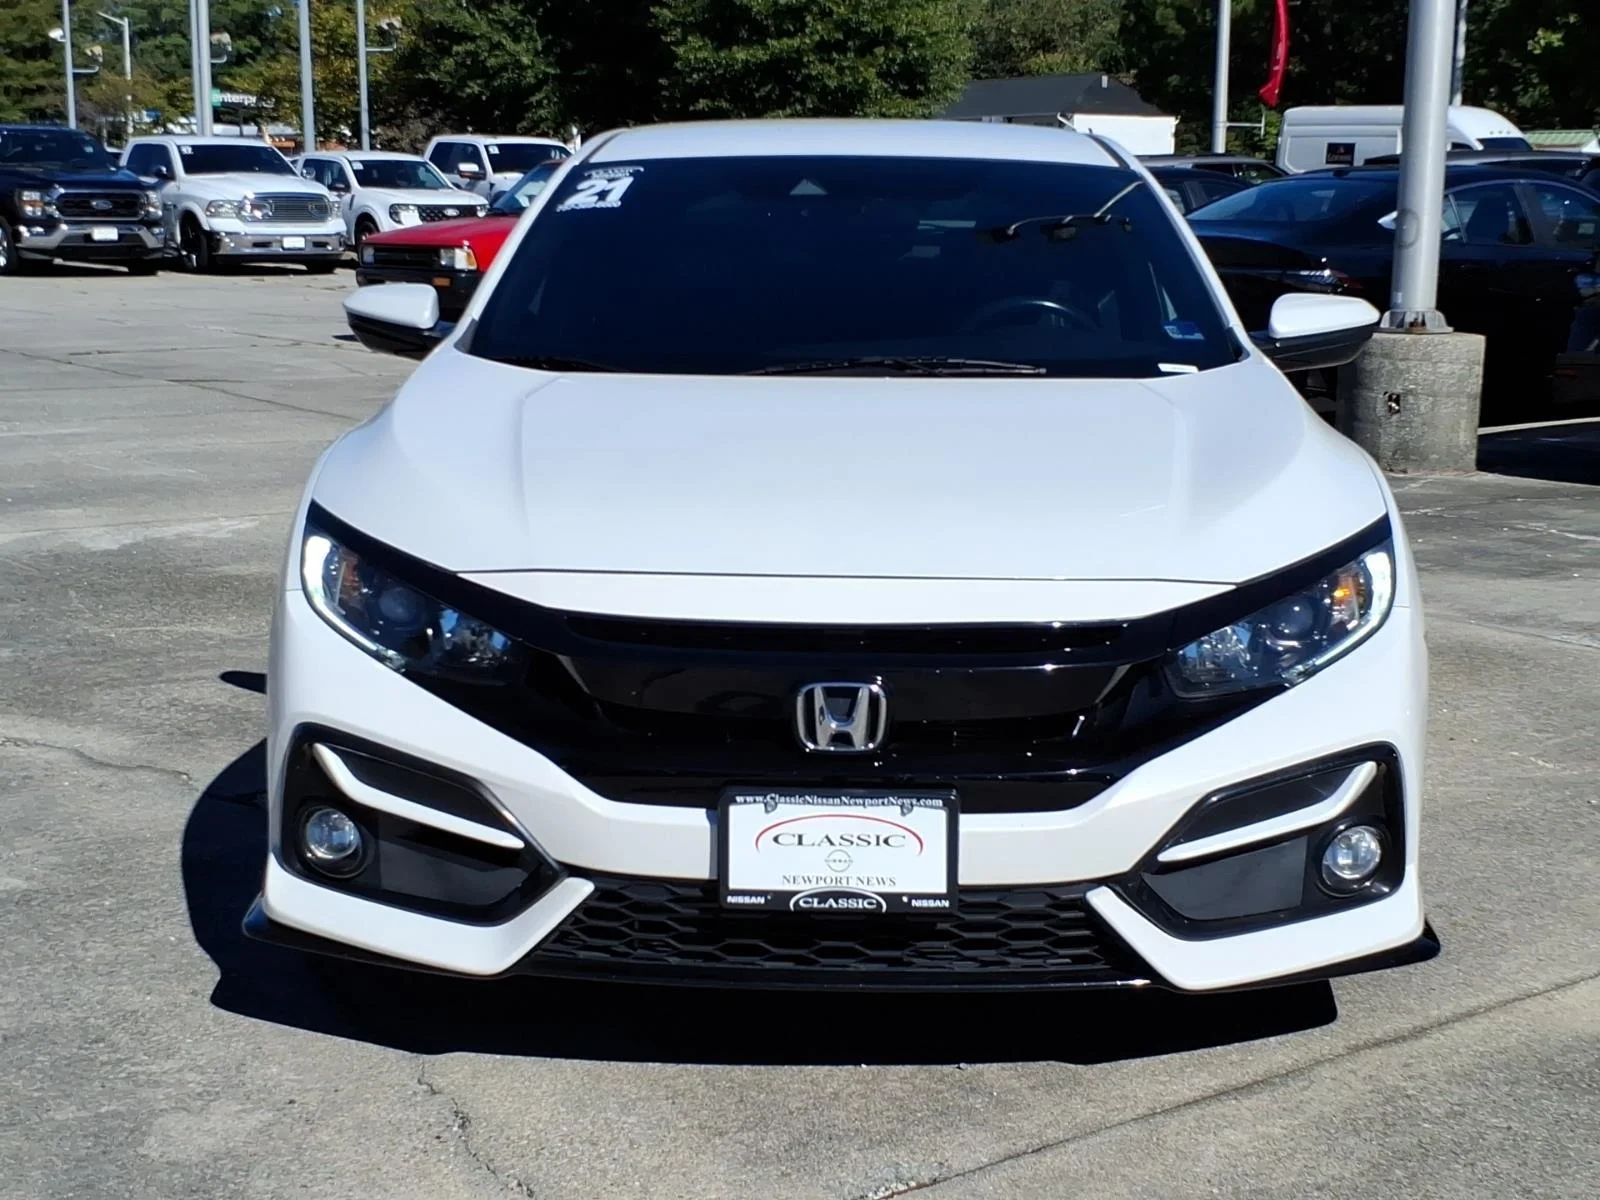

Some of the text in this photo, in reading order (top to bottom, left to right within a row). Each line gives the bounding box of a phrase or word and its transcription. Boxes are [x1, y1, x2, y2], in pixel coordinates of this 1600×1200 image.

[772, 832, 906, 848] CLASSIC
[782, 874, 897, 887] NEWPORT NEWS
[727, 895, 766, 904] NISSAN
[798, 898, 878, 909] CLASSIC
[911, 898, 950, 908] NISSAN
